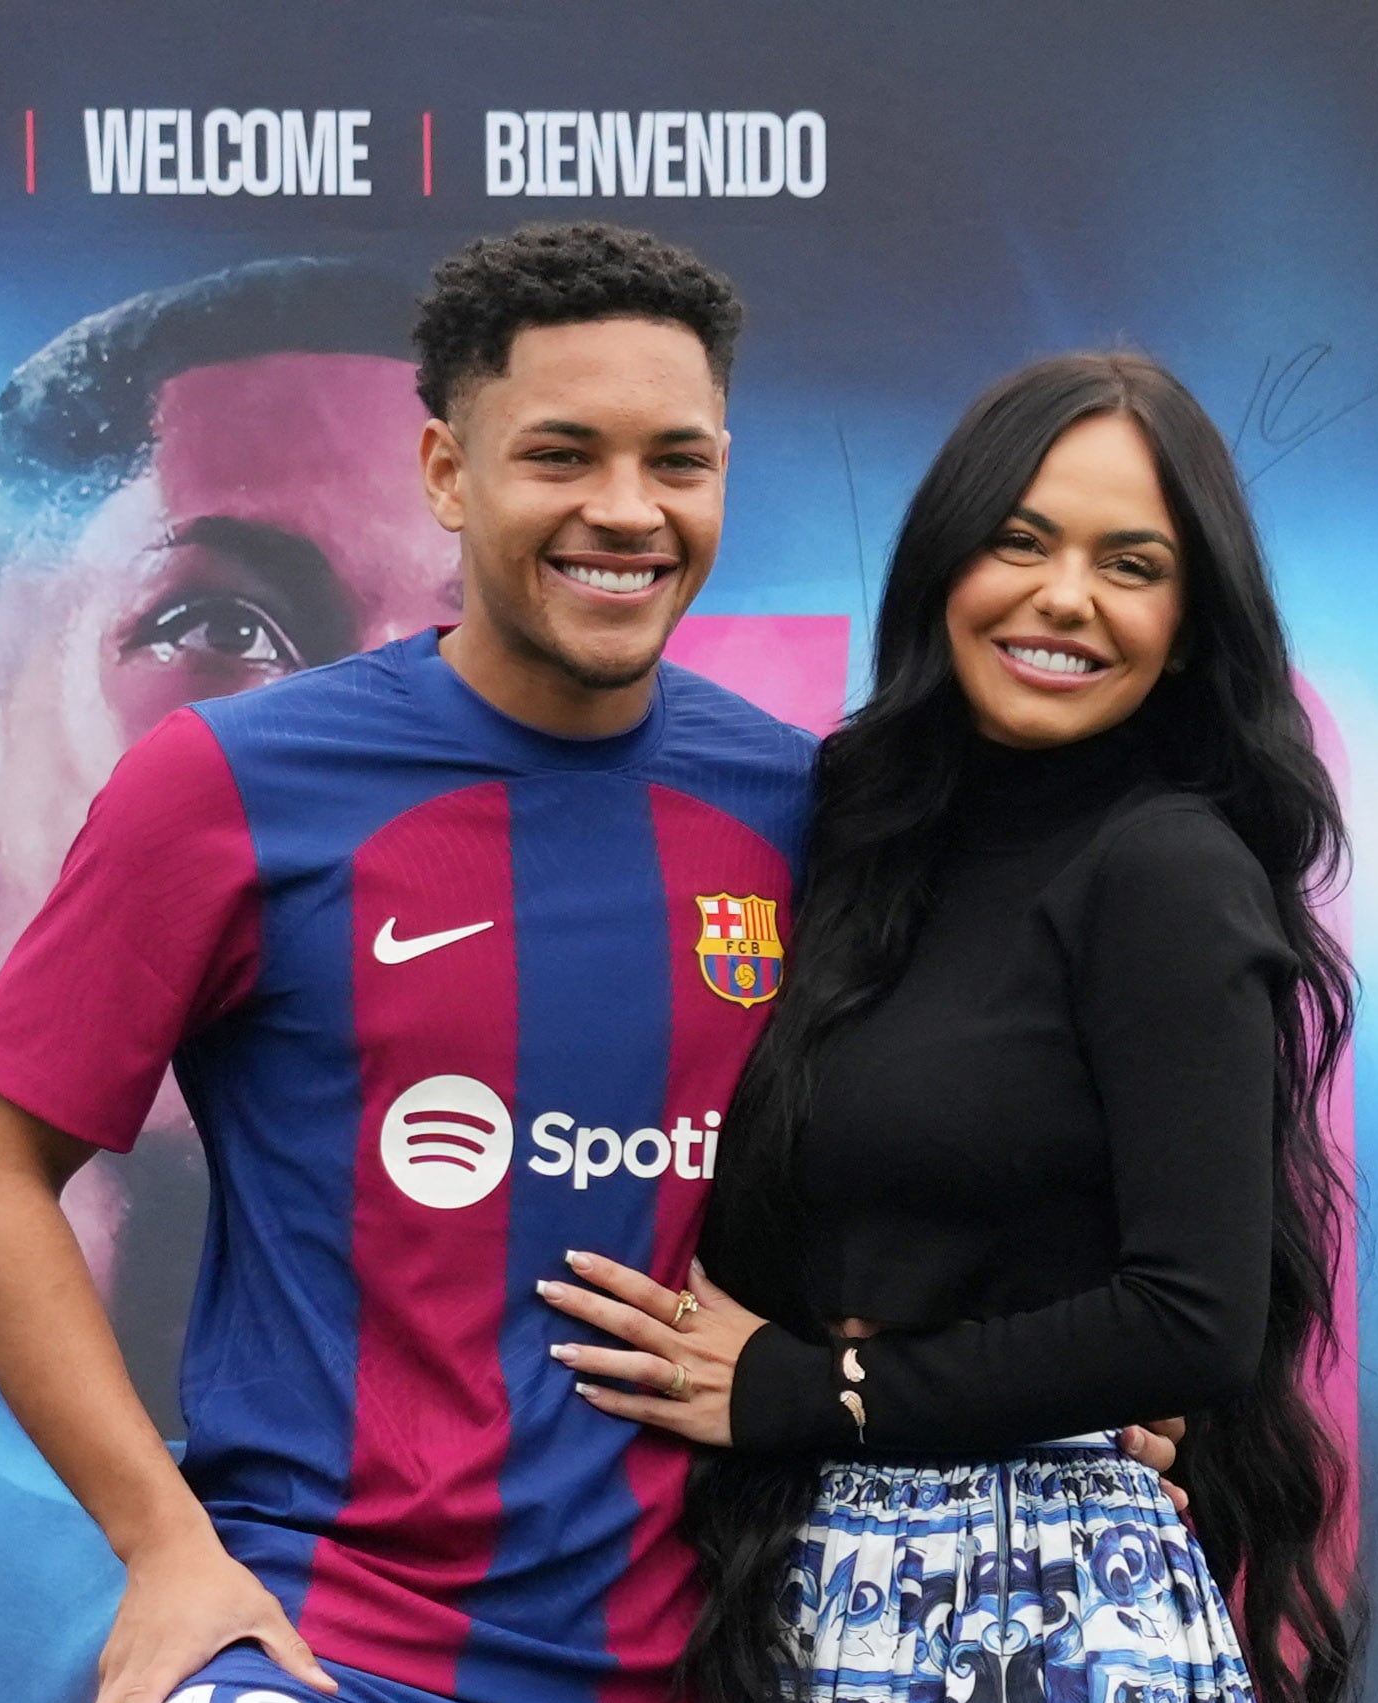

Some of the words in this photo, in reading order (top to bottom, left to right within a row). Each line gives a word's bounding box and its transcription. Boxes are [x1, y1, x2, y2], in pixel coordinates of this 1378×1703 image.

[83, 107, 373, 197] WELCOME
[484, 110, 828, 197] BIENVENIDO
[725, 940, 761, 955] FCB
[528, 1109, 721, 1190] Spoti
